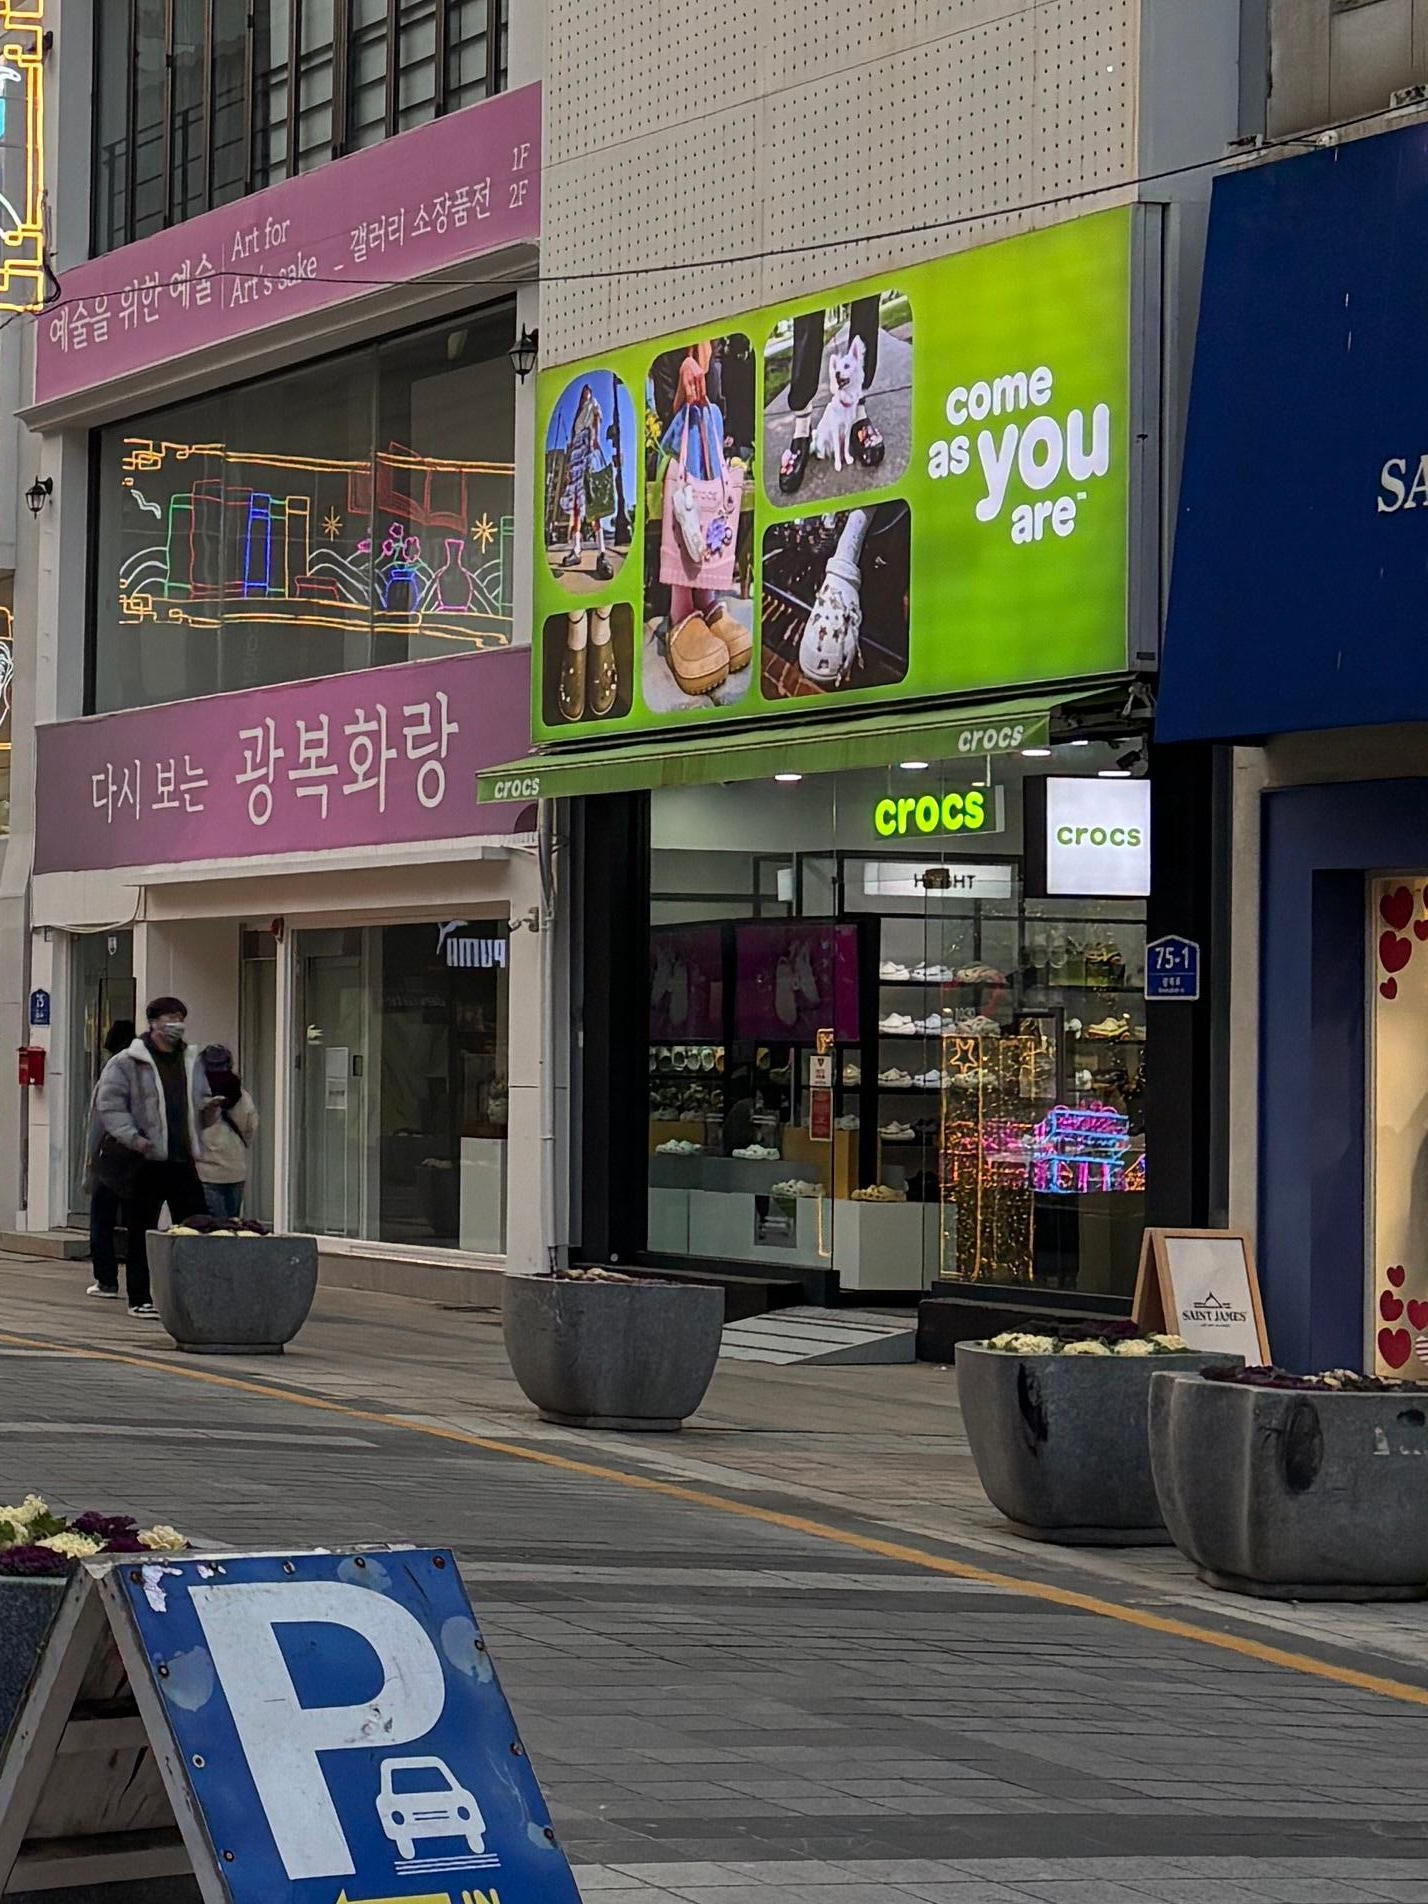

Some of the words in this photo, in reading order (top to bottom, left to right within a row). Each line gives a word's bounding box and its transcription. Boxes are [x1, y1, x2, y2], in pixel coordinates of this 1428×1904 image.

[512, 144, 529, 172] 1F
[509, 180, 528, 209] 2F
[232, 226, 259, 261] Art
[264, 217, 290, 244] for
[350, 209, 404, 263] 갤러리
[410, 178, 491, 244] 소장품전
[49, 298, 110, 353] 예술을
[119, 273, 159, 331] 위한
[170, 254, 214, 309] 예술
[231, 264, 273, 308] Art's
[279, 254, 317, 283] sake
[945, 365, 1052, 425] come
[928, 436, 969, 479] as
[975, 402, 1110, 523] you
[1010, 498, 1076, 544] are
[91, 758, 140, 823] 다시
[152, 754, 208, 813] 보는
[234, 691, 458, 826] 광복화랑
[957, 722, 1024, 751] crocs
[493, 776, 539, 799] crocs
[874, 790, 984, 836] crocs
[1056, 823, 1141, 847] crocs
[1155, 946, 1189, 969] 75-1
[188, 1581, 447, 1881] P
